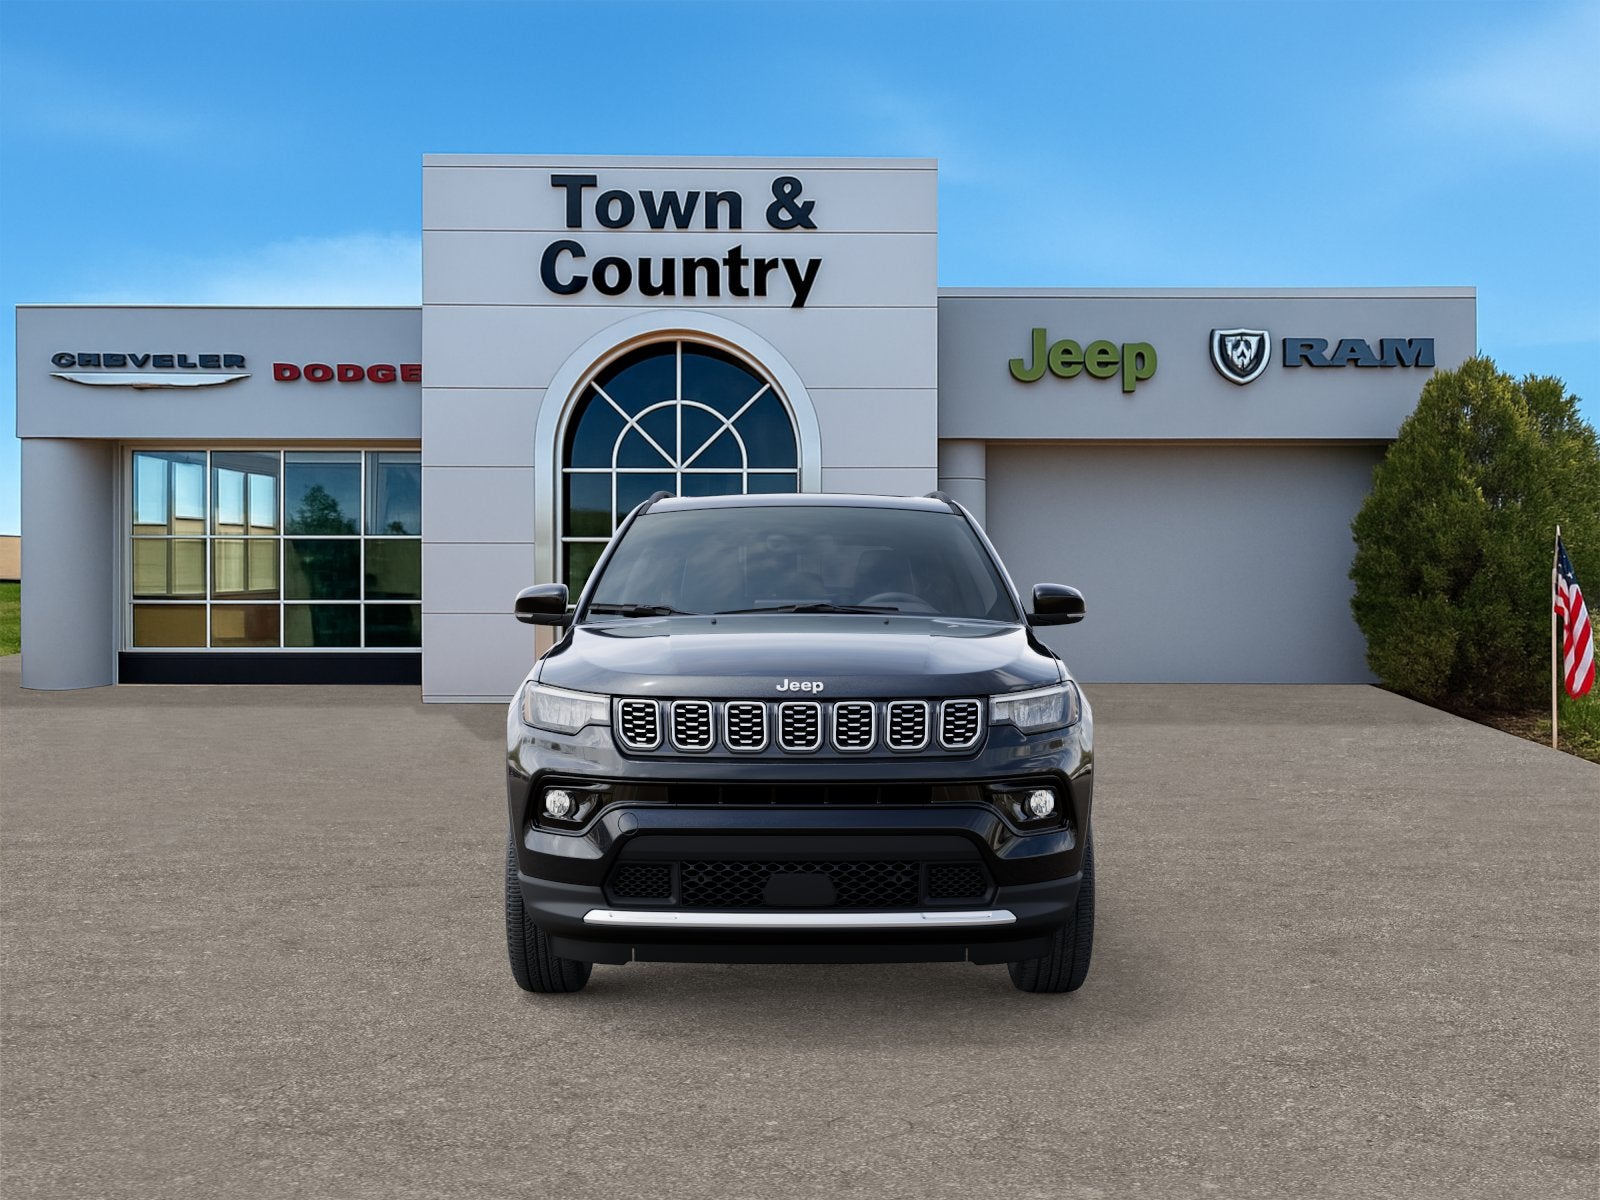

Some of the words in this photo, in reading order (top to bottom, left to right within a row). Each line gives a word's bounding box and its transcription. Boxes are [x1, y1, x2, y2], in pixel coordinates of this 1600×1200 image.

[551, 174, 743, 230] Town
[766, 175, 818, 230] &
[540, 239, 822, 308] Country
[273, 362, 422, 383] DODGE
[1009, 328, 1158, 393] Jeep
[1282, 337, 1436, 368] RAM
[776, 678, 824, 694] Jeep
